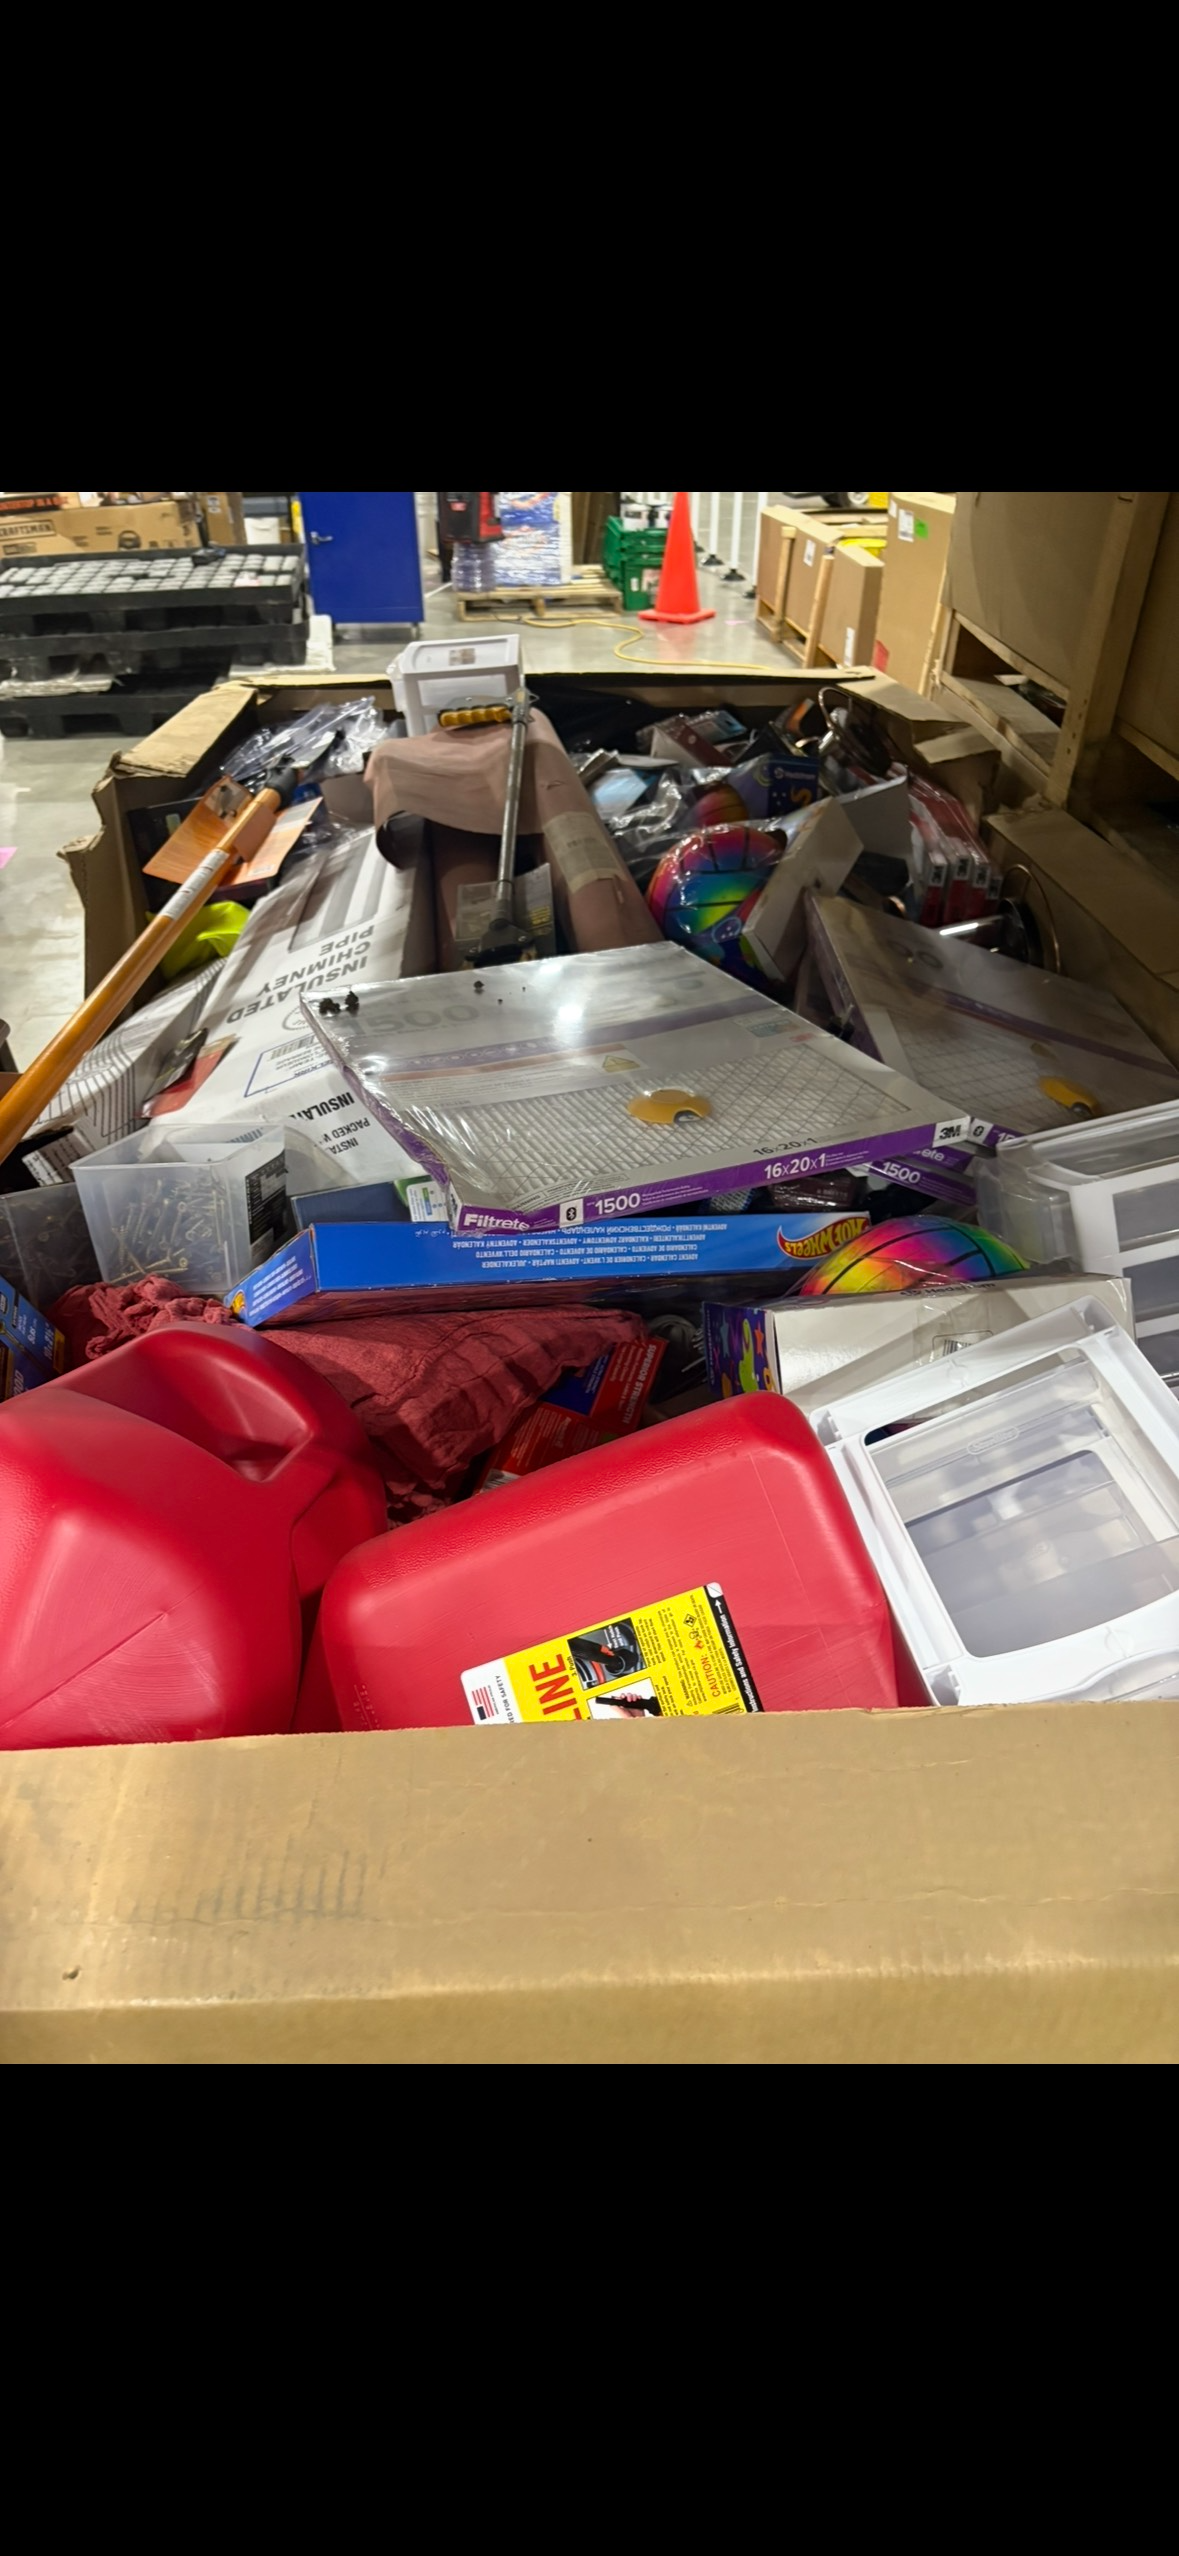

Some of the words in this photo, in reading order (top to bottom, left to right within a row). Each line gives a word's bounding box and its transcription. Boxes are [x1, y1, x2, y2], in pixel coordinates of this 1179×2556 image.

[319, 924, 375, 957] PIPE
[259, 941, 372, 996] CHIMNEY
[227, 956, 366, 1024] INSULATED
[345, 1004, 480, 1037] 1500
[289, 1092, 355, 1121] INSULA
[333, 1118, 371, 1140] PACKED
[939, 1124, 962, 1139] 3M
[753, 1137, 818, 1155] 16x20x1
[764, 1153, 826, 1179] 16x20x1
[882, 1161, 920, 1184] 1500
[595, 1193, 640, 1215] 1500
[463, 1213, 530, 1232] Filtrete
[636, 1343, 657, 1381] SUPERIOR
[620, 1381, 644, 1424] STRENGTH
[719, 1613, 737, 1648] Information
[565, 1655, 575, 1670] Push
[729, 1646, 744, 1667] Safety
[701, 1654, 721, 1697] CAUTION:
[736, 1666, 747, 1679] and
[494, 1674, 506, 1698] SAFETY
[742, 1678, 760, 1712] Instructions
[502, 1698, 511, 1711] FOR
